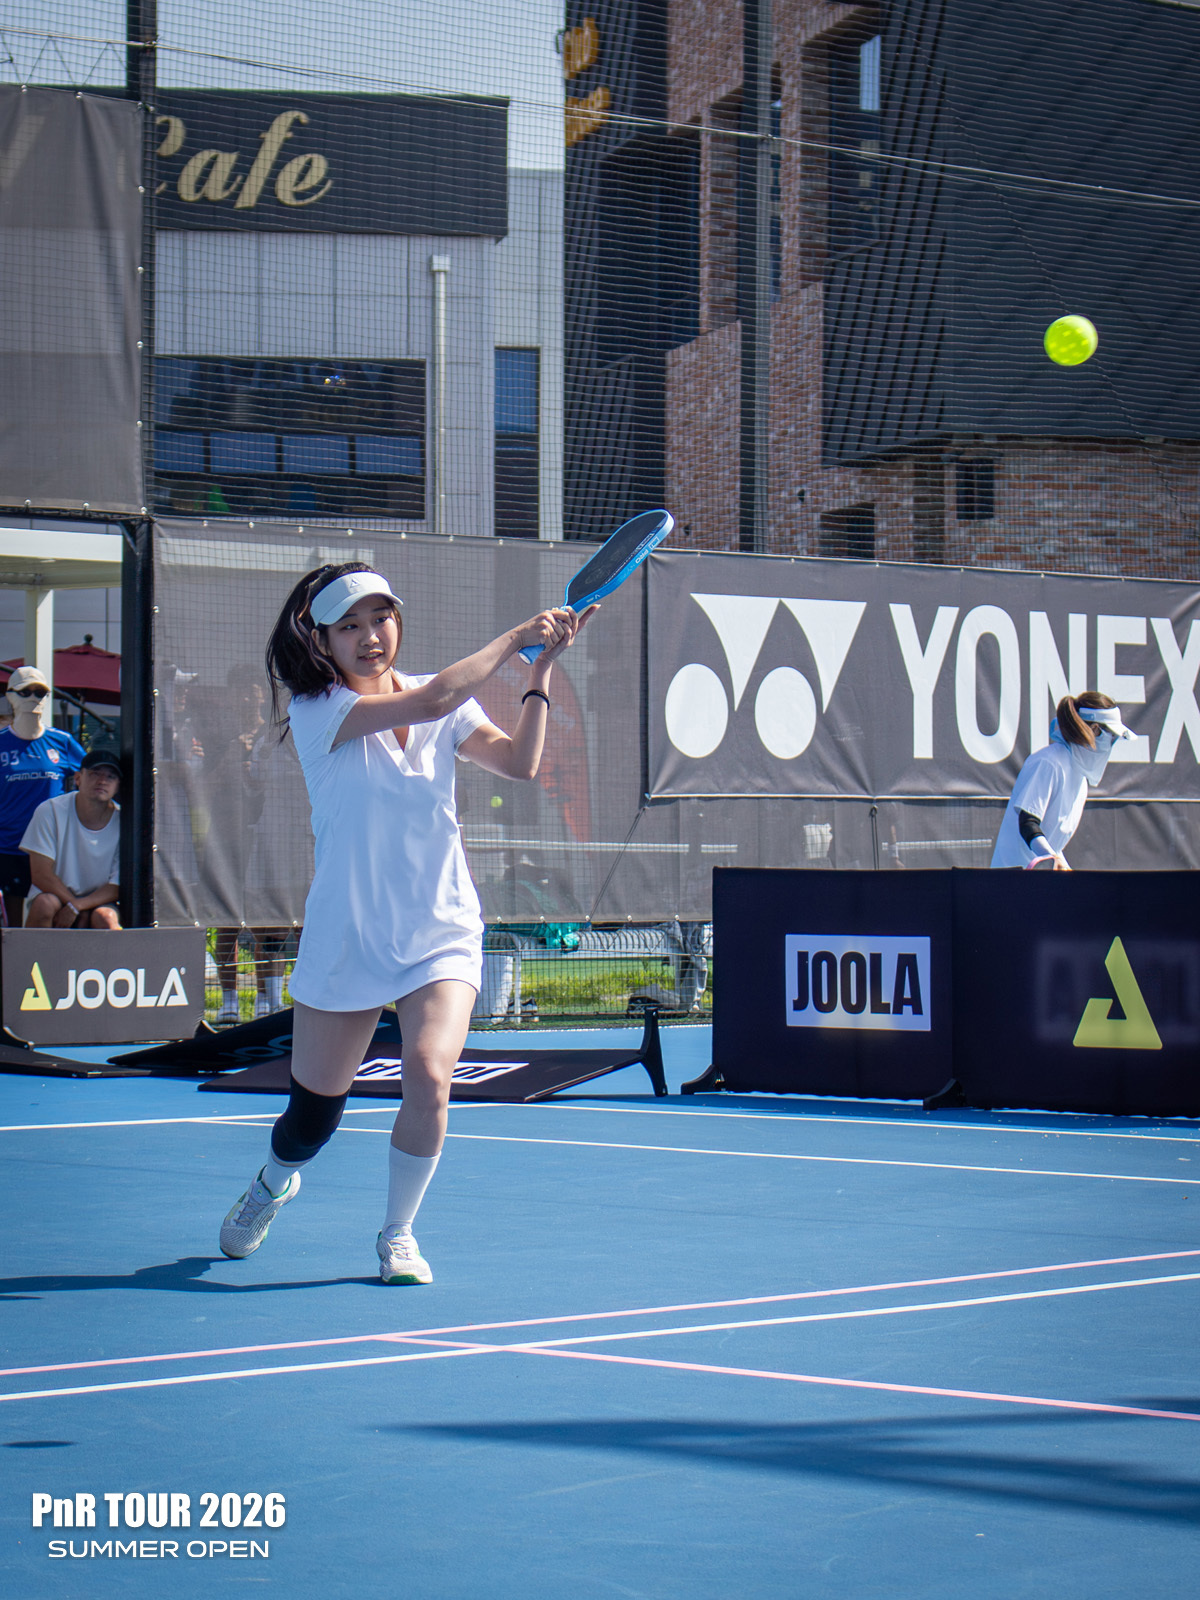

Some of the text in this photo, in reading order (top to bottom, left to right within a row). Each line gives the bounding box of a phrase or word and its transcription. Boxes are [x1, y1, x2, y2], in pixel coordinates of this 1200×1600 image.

[889, 603, 1200, 764] YONEX
[0, 750, 20, 767] 93
[55, 967, 189, 1010] JOOLA
[792, 950, 924, 1016] JOOLA
